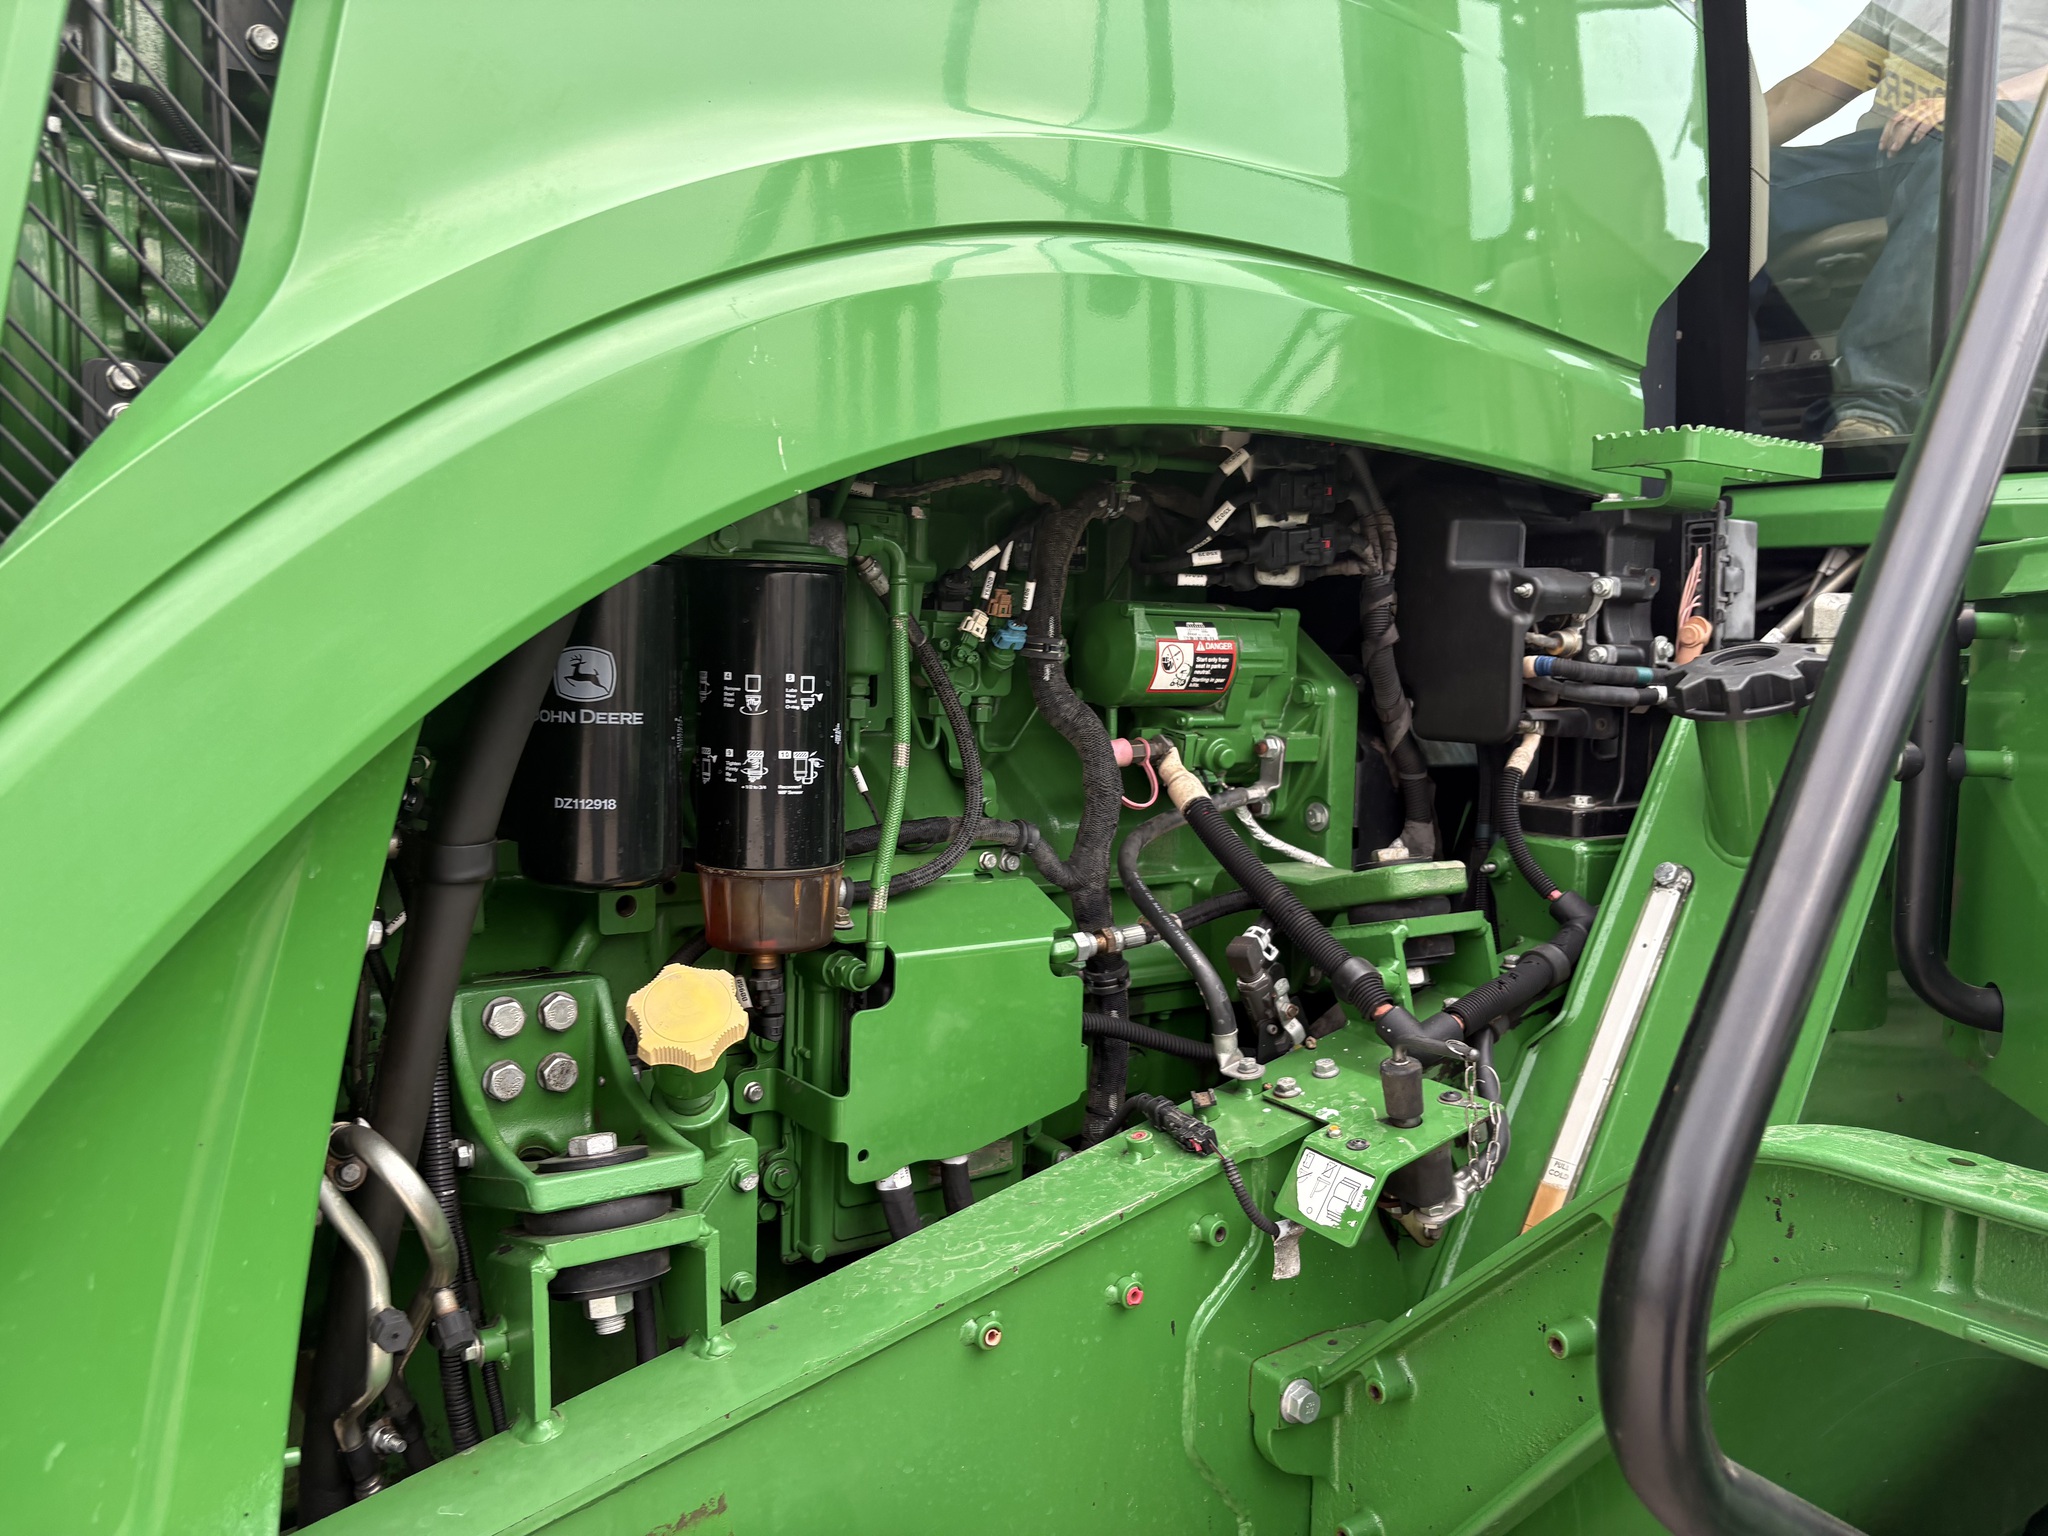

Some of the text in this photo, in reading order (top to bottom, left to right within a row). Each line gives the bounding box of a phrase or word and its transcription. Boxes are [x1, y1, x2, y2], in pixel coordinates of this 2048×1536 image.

[1205, 642, 1233, 650] DANGER
[536, 709, 644, 725] OHN DEERE
[554, 797, 617, 810] DZ112918
[1554, 1161, 1569, 1171] FULL
[1549, 1169, 1569, 1180] COLD
